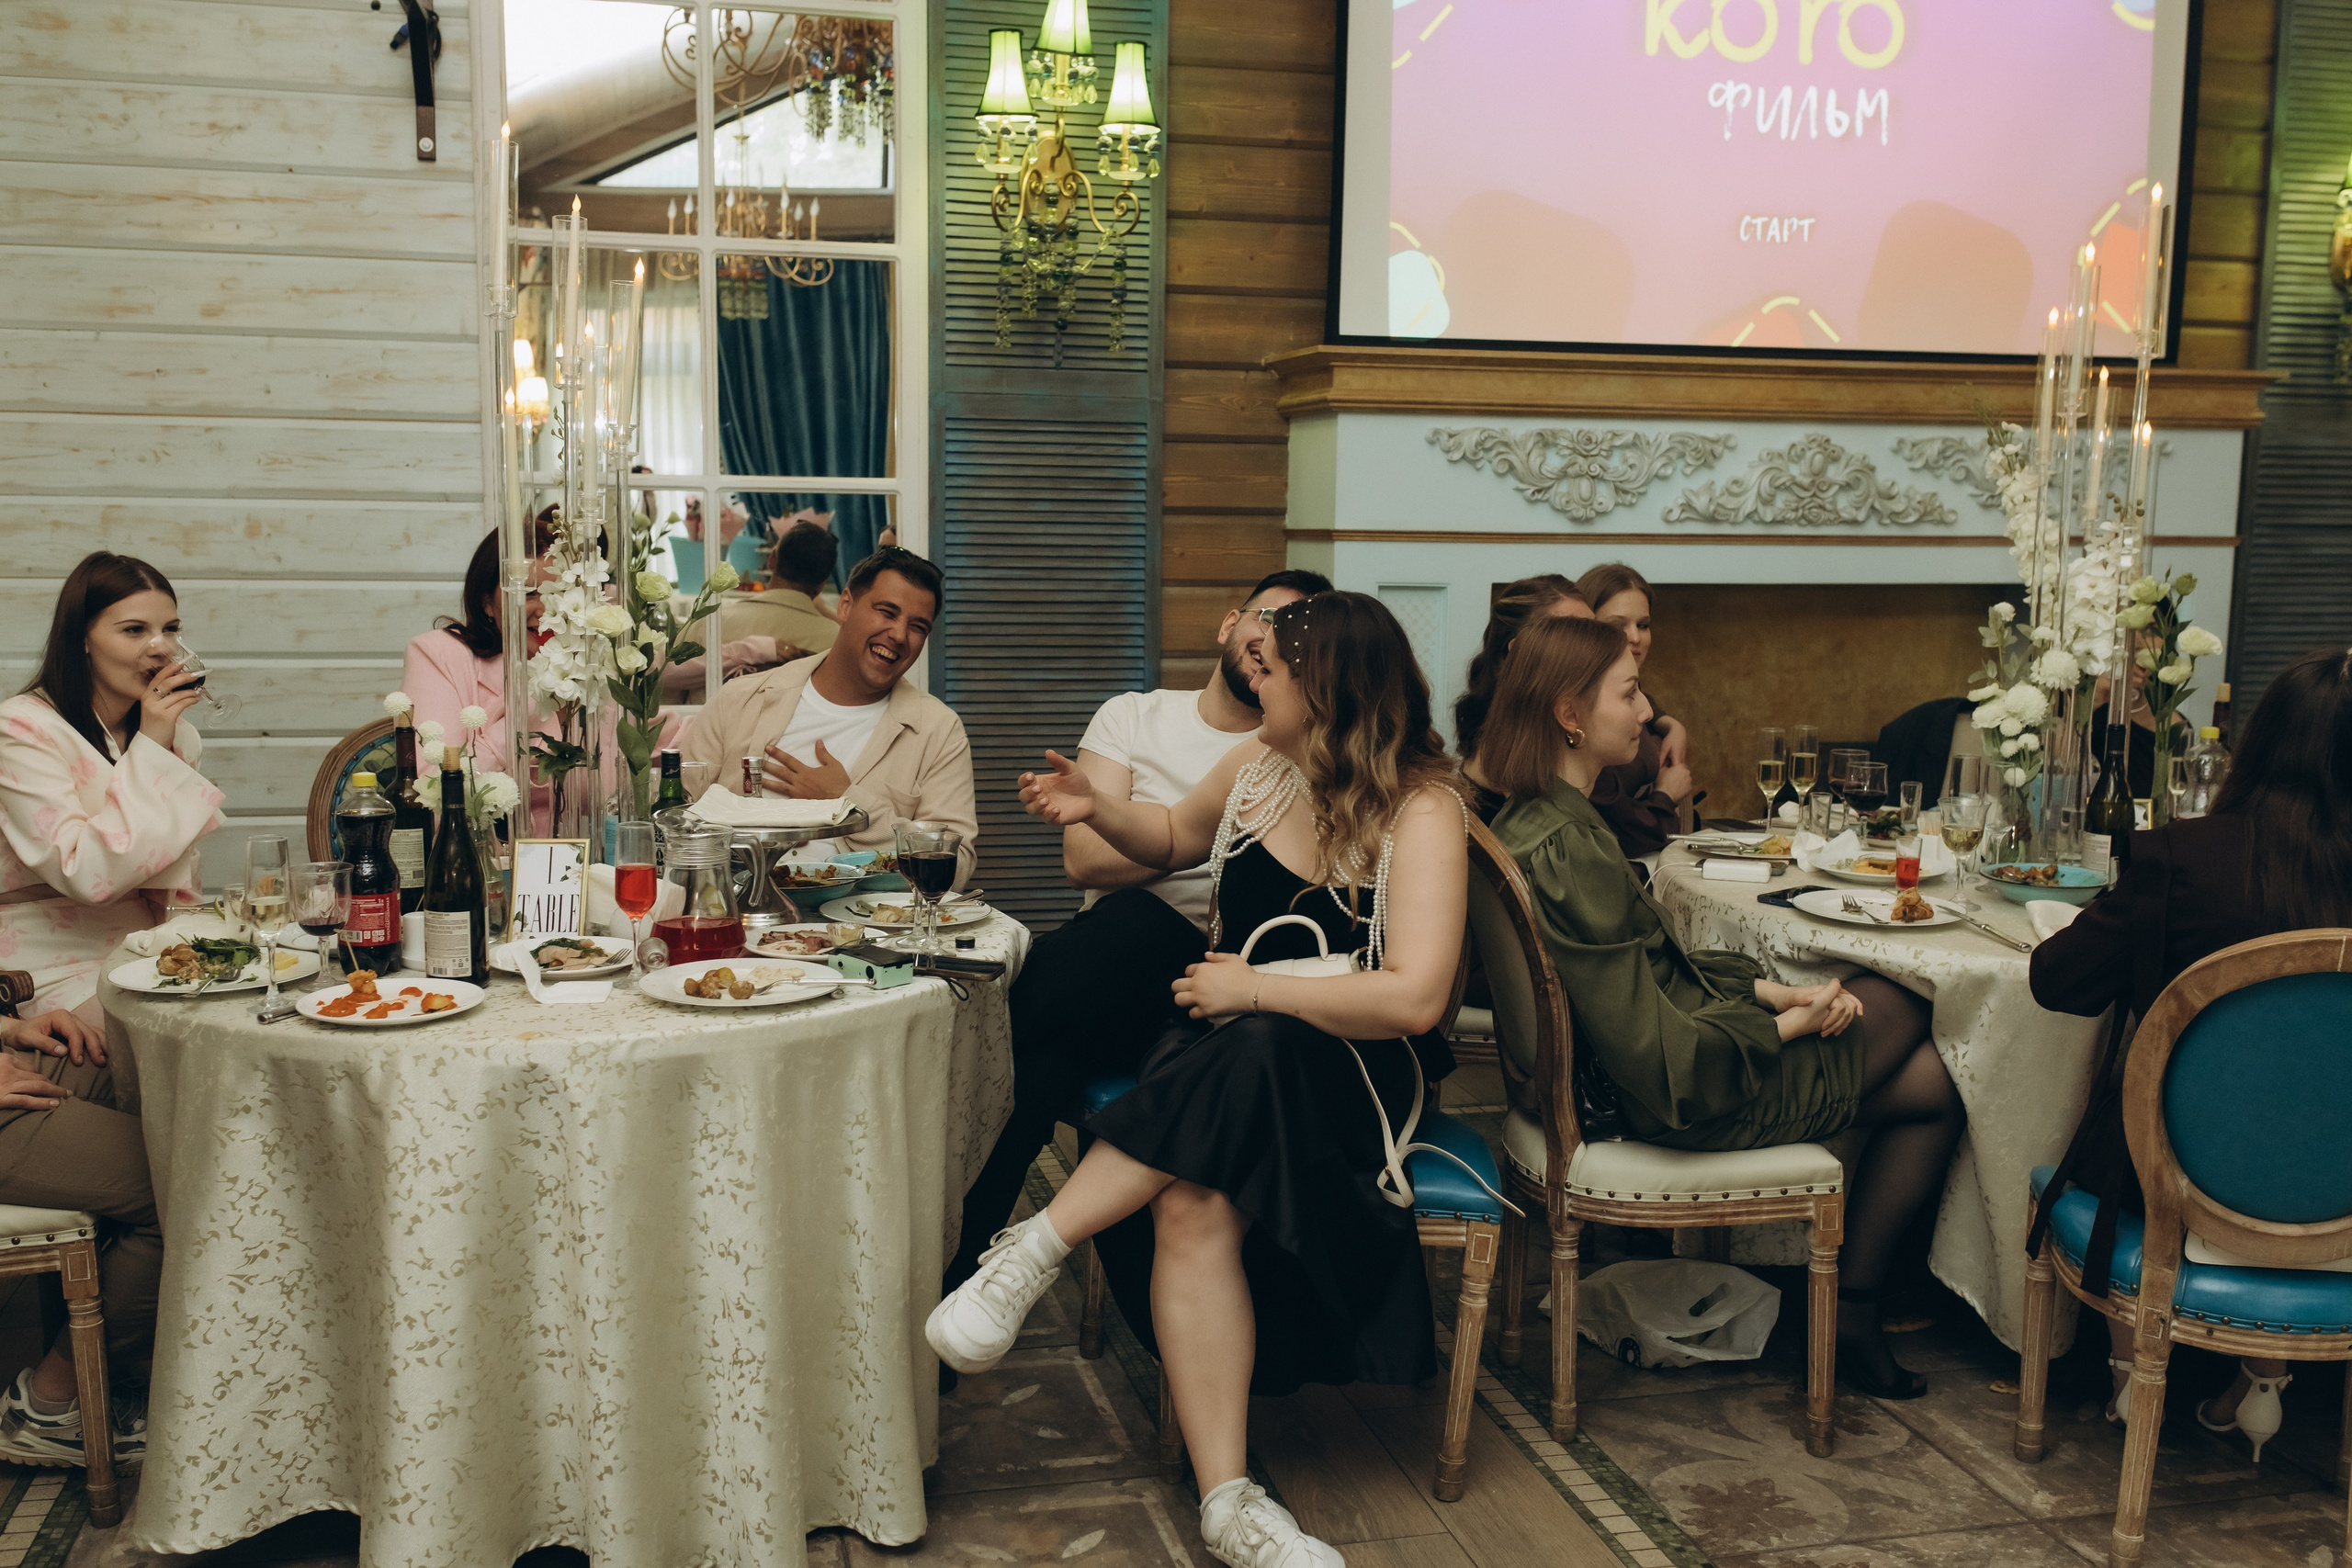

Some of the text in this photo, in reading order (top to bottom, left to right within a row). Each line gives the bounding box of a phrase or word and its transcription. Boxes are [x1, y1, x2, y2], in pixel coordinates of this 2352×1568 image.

[1707, 79, 1889, 146] ФИЛЬМ
[1739, 215, 1816, 243] СТАРТ
[517, 894, 580, 932] TABLE
